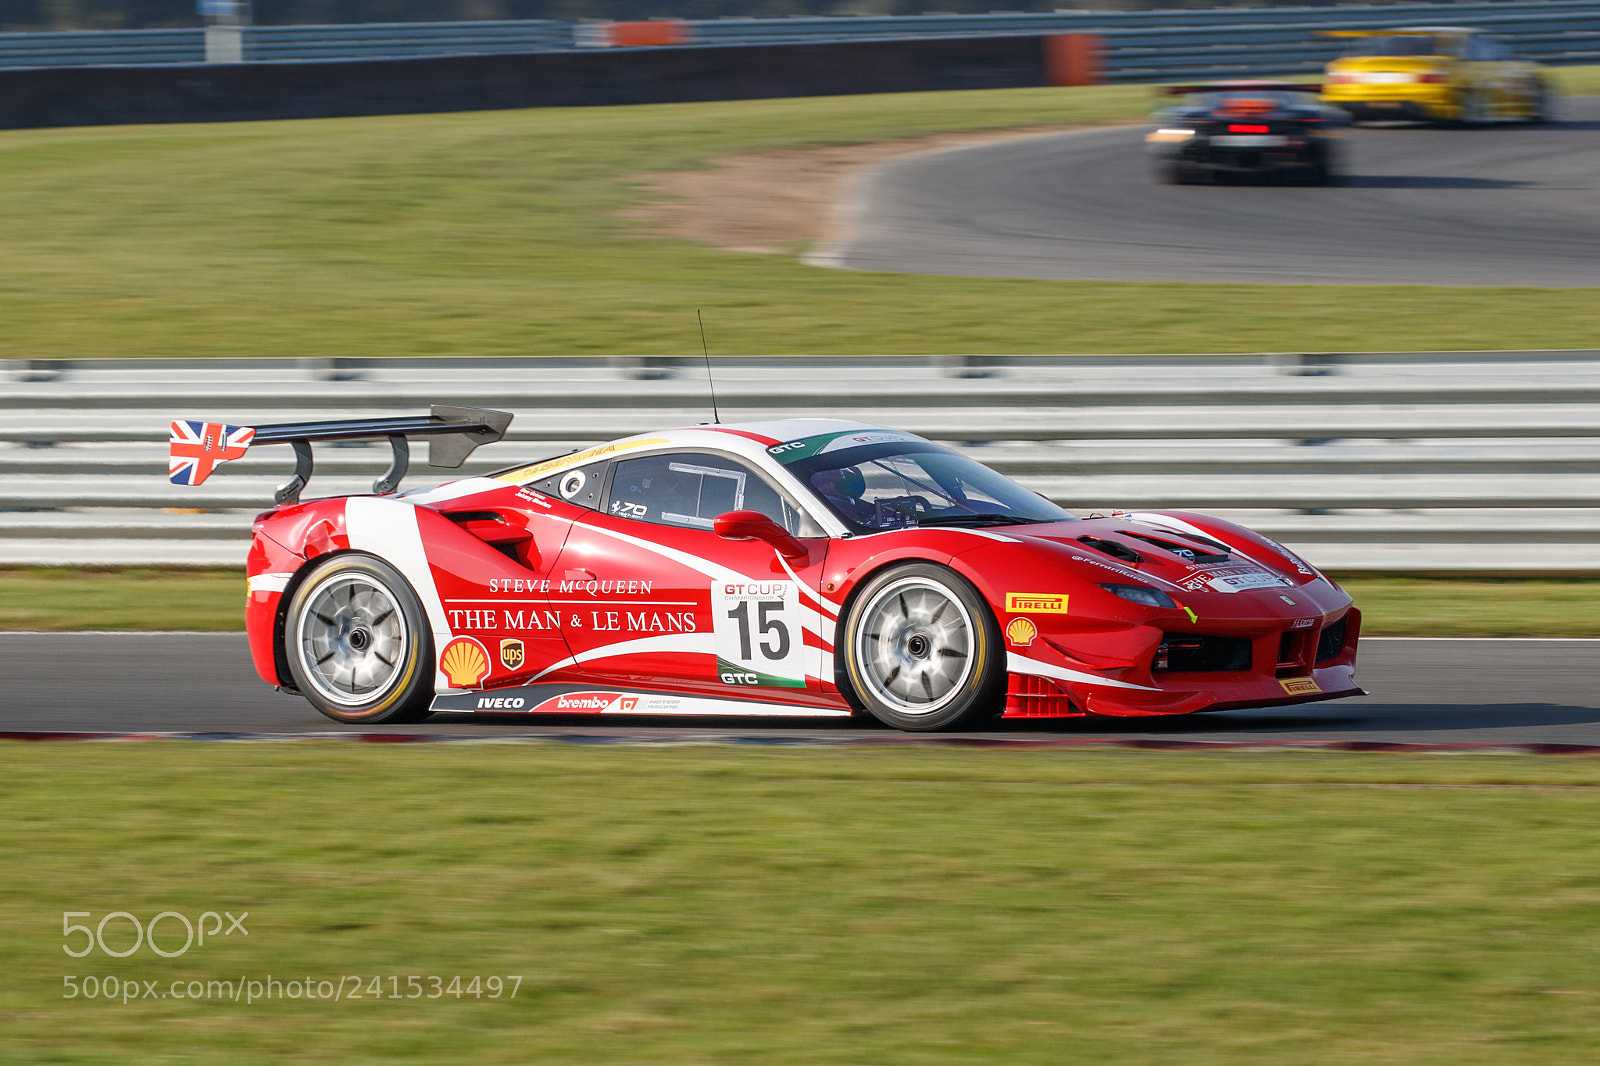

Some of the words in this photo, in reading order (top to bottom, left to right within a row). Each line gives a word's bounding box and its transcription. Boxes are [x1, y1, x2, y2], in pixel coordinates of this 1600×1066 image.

[769, 442, 806, 454] GTC
[620, 501, 648, 516] 70
[489, 578, 550, 594] STEVE
[724, 584, 745, 595] GT
[747, 584, 782, 595] CUP
[1012, 597, 1063, 610] PIRELLI
[448, 609, 498, 630] THE
[504, 610, 561, 630] MAN
[570, 614, 583, 628] &
[591, 611, 621, 632] LE
[626, 612, 697, 632] MANS
[727, 600, 790, 661] 15
[720, 672, 759, 685] GTC
[1285, 680, 1318, 692] PIRELLI
[477, 697, 525, 709] IVECO
[557, 696, 609, 710] brembo
